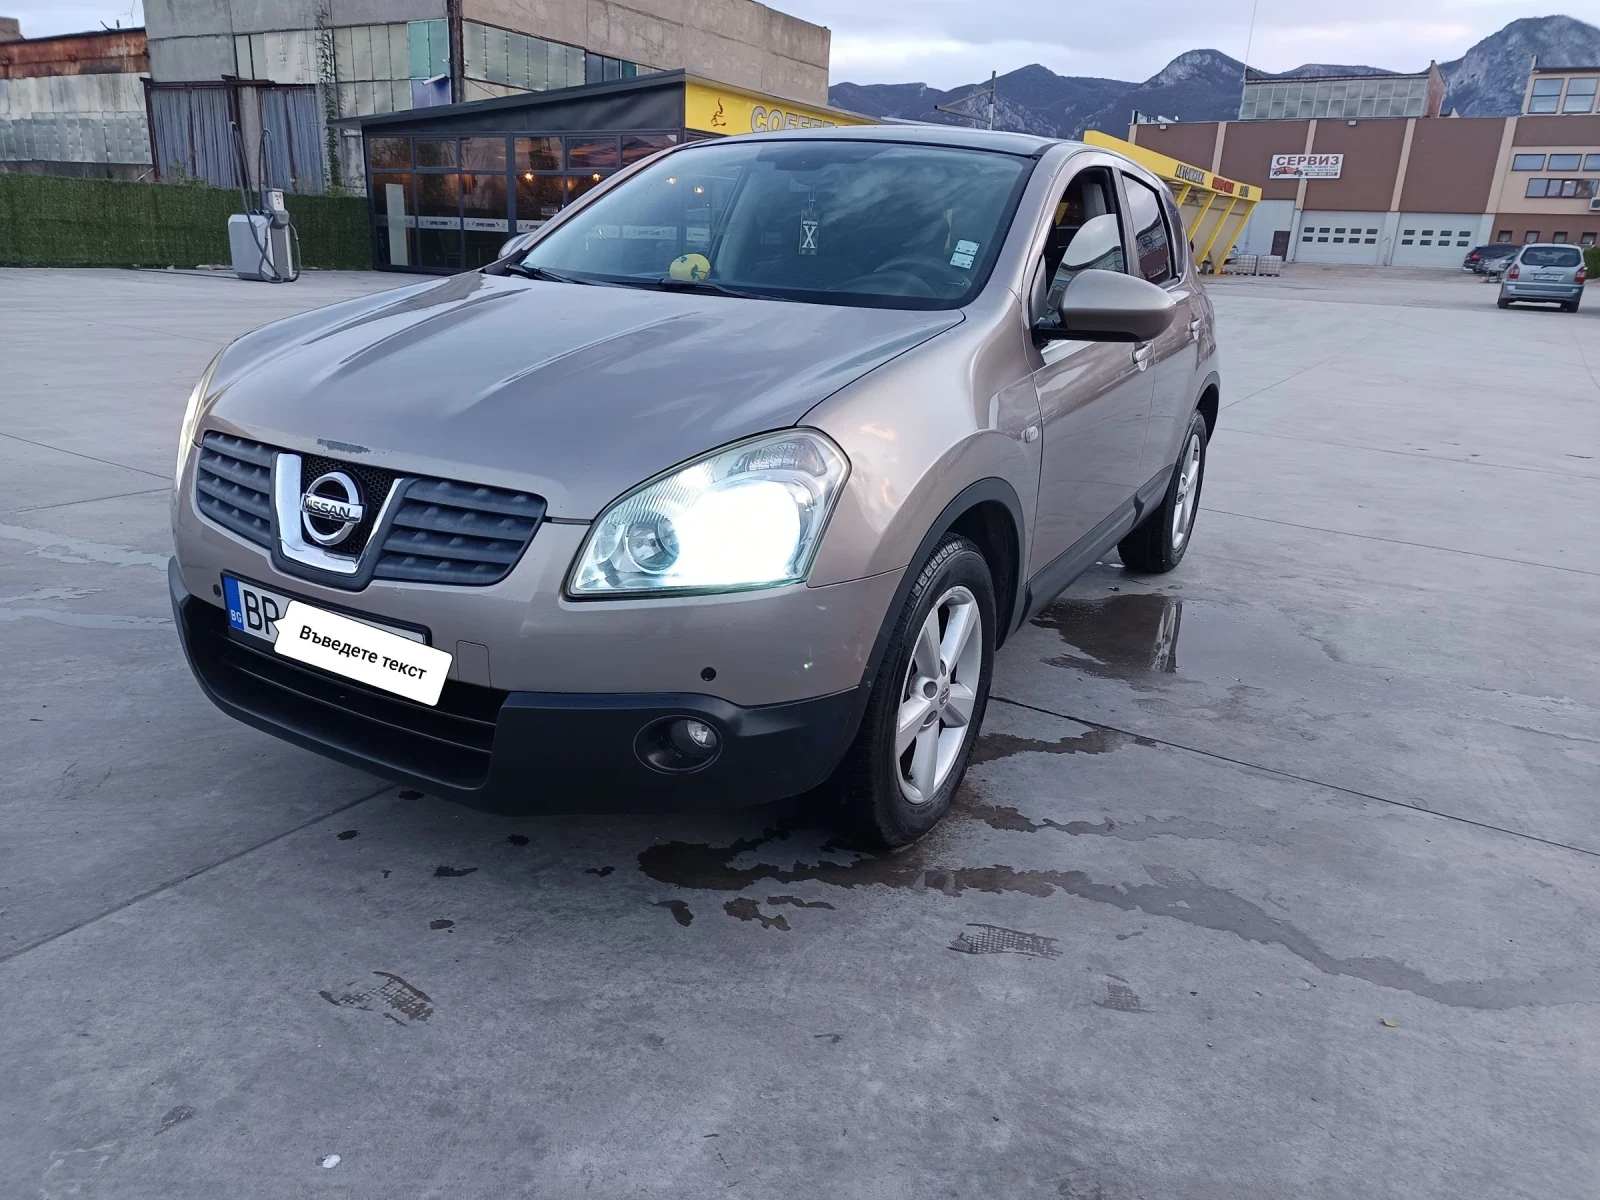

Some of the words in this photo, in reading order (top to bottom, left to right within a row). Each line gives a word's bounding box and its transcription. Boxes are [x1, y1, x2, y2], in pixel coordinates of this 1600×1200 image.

[1276, 156, 1340, 166] СЕРВИЗ
[802, 225, 817, 249] X
[302, 495, 351, 517] NISSAN
[230, 610, 242, 624] BG
